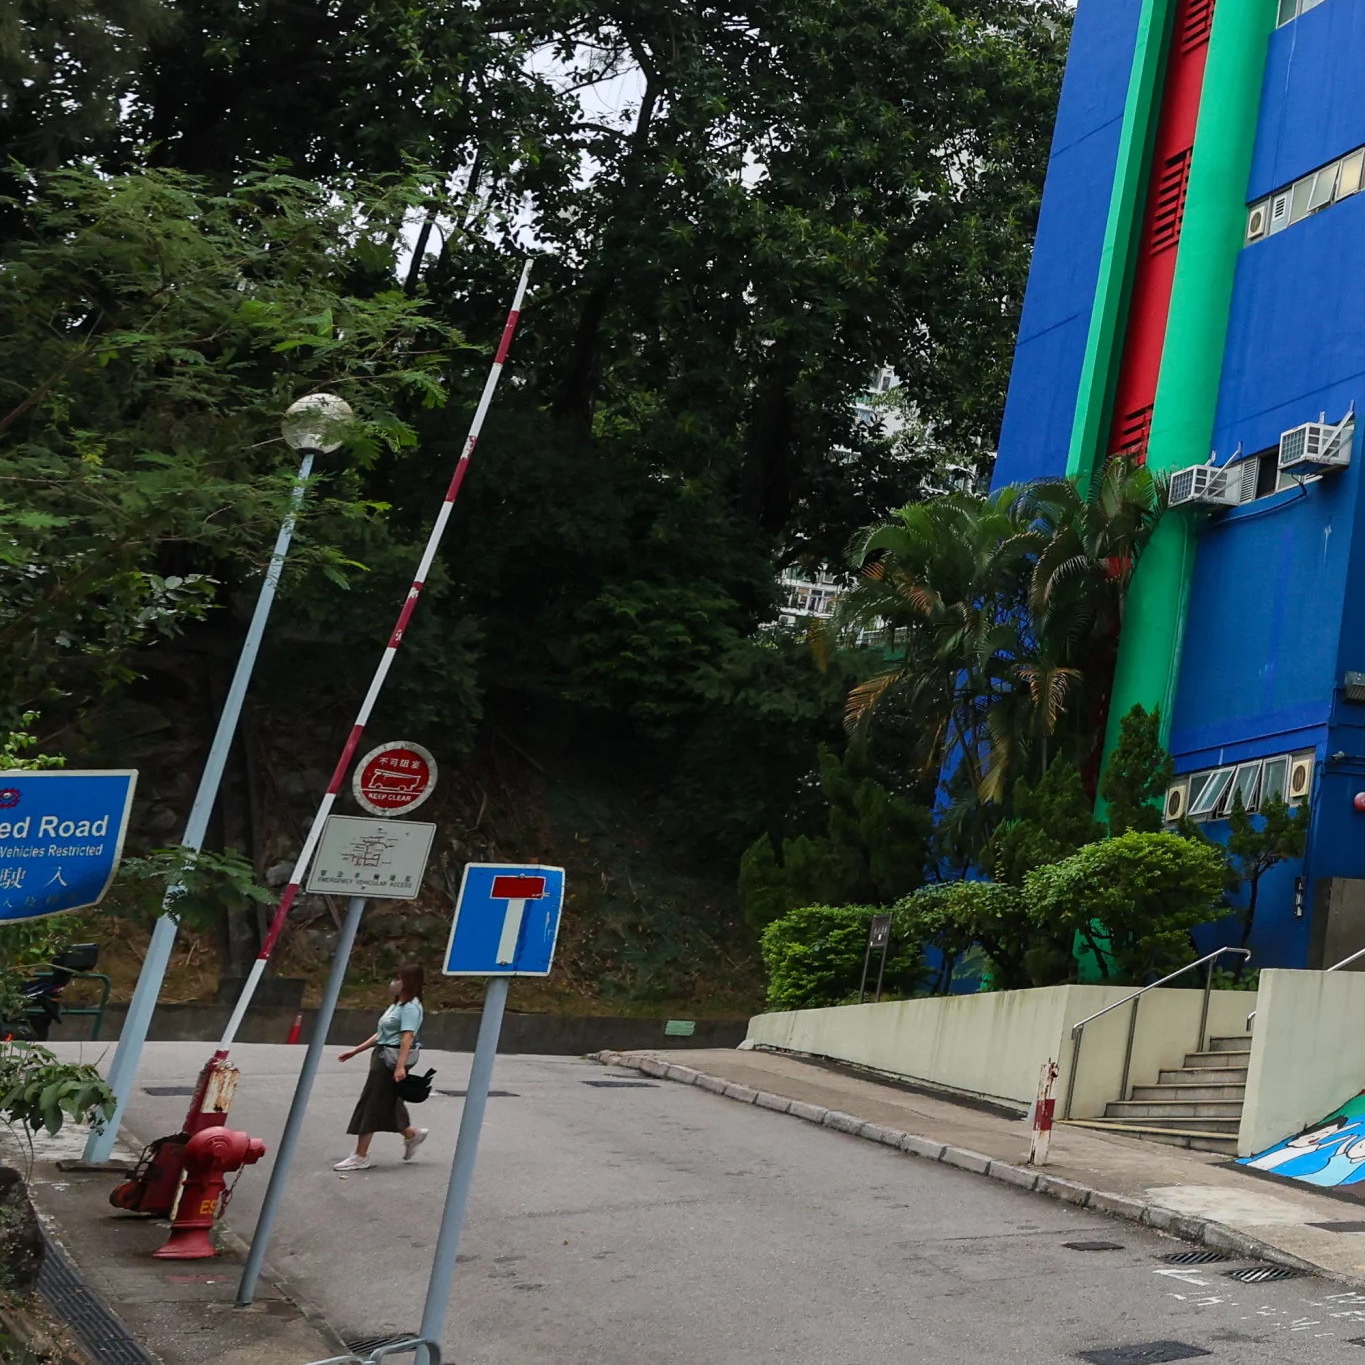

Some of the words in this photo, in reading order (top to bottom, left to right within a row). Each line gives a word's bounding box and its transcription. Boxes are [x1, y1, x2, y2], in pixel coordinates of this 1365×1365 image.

[387, 794, 412, 802] CLEAR
[38, 814, 109, 838] Road
[0, 846, 45, 858] Vehicles
[47, 844, 103, 857] Restricted
